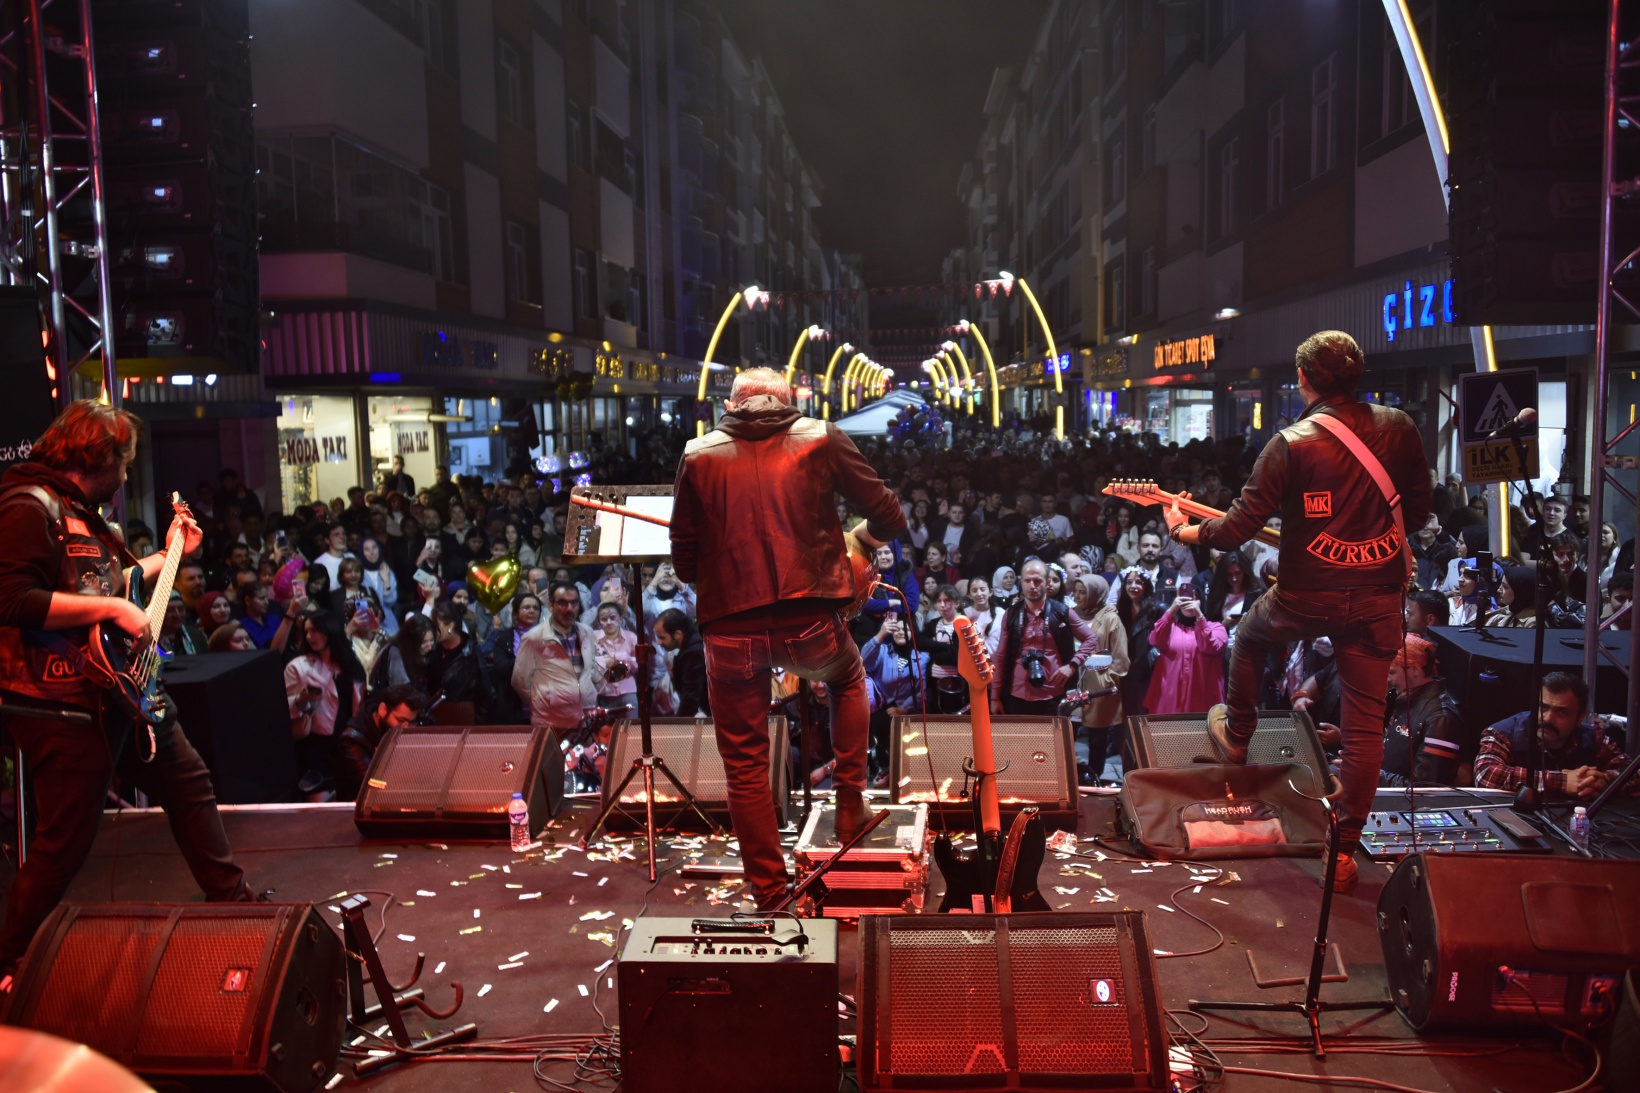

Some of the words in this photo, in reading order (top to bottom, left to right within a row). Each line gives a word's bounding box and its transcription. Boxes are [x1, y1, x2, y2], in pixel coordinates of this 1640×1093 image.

[1185, 337, 1200, 364] SPOT
[286, 437, 320, 466] MODA
[322, 435, 348, 462] TAKI
[397, 431, 415, 454] MODA
[415, 430, 430, 453] TAKI
[1307, 496, 1329, 512] MK
[1204, 806, 1252, 814] HEADRUSH
